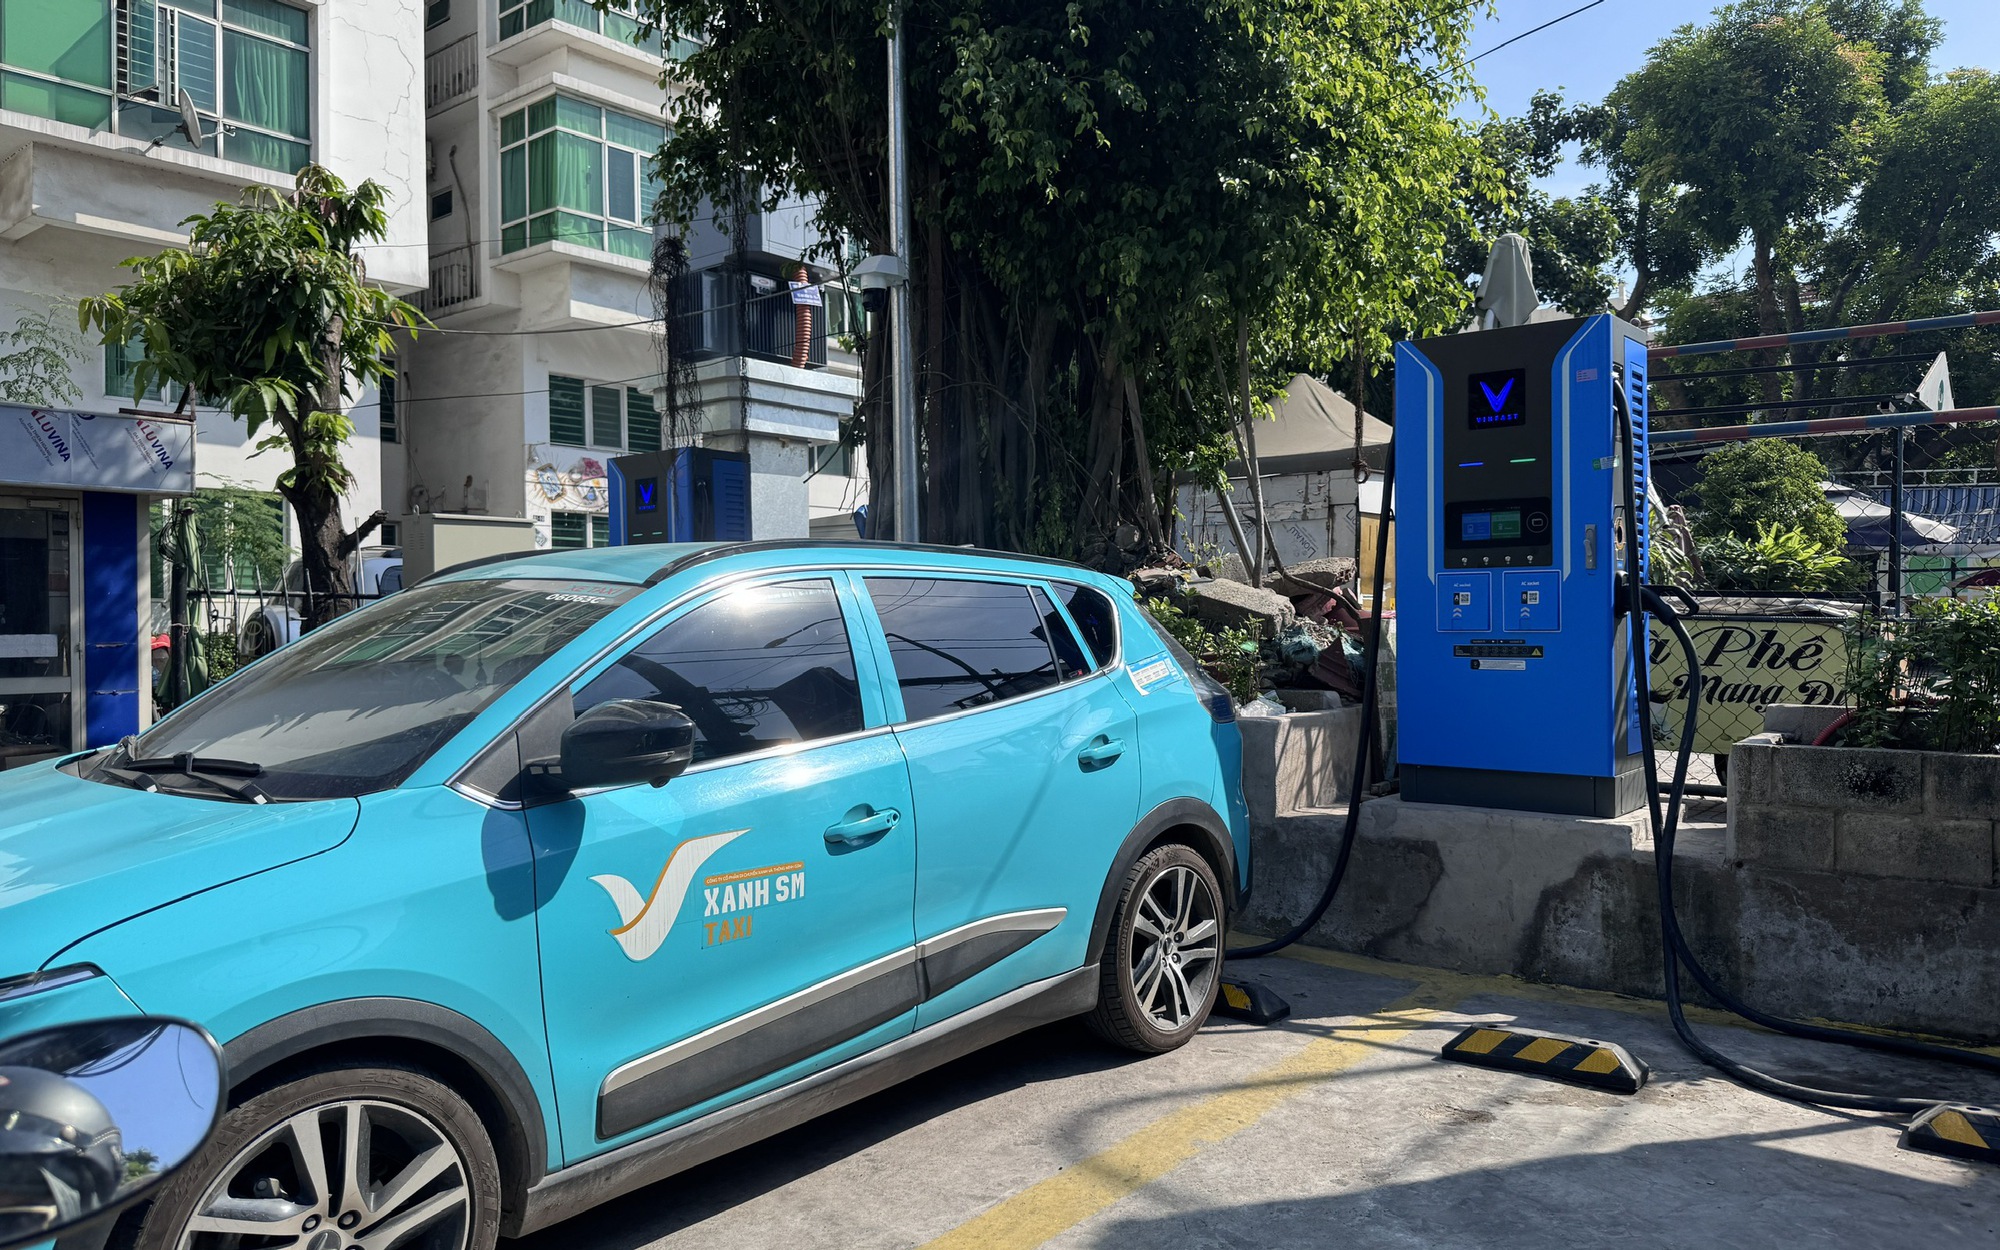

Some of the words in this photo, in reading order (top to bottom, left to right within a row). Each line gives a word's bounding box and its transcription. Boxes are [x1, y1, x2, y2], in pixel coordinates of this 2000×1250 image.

[1476, 413, 1519, 424] VINFAST
[1690, 625, 1829, 671] Phê
[1673, 674, 1785, 713] Mang
[704, 878, 769, 917] XANH
[775, 872, 805, 902] SM
[704, 915, 752, 946] TAXI
